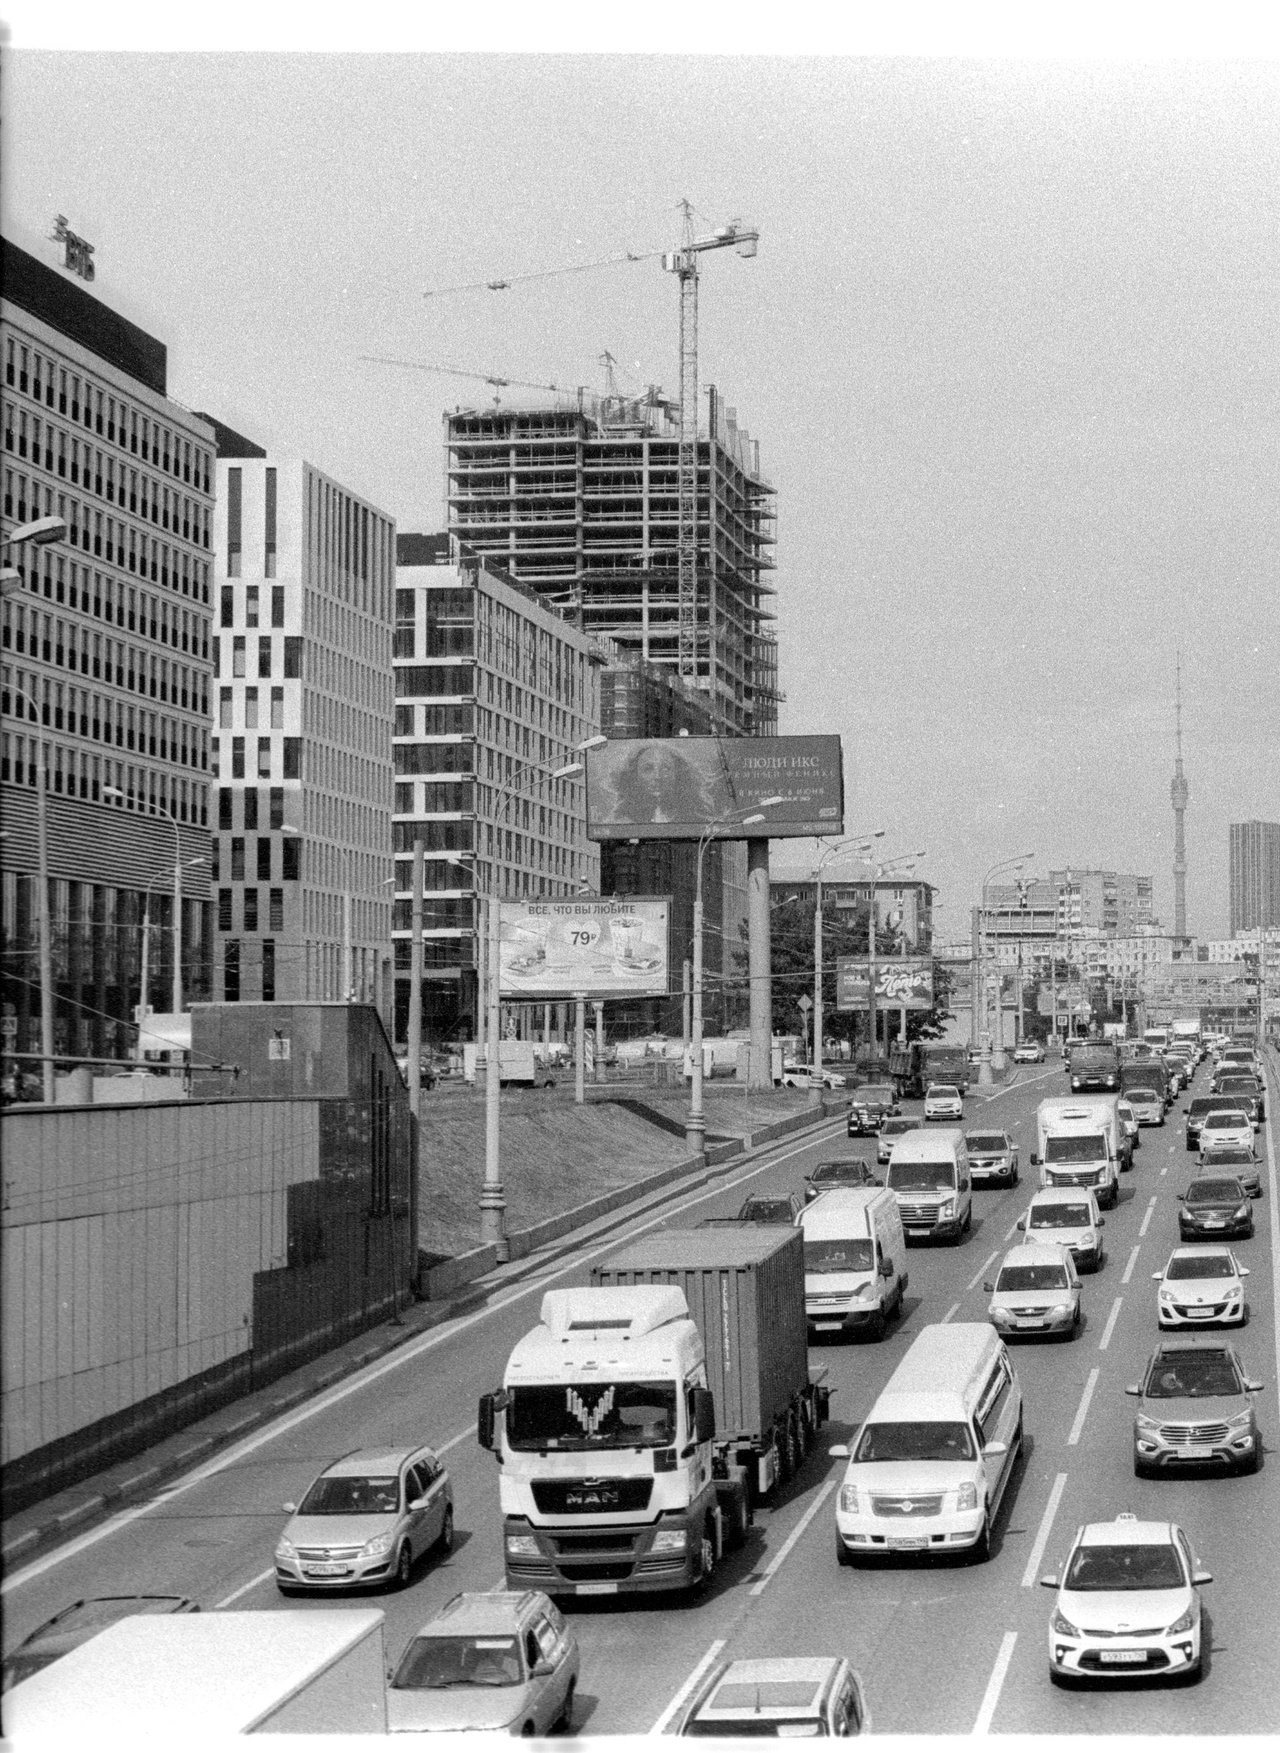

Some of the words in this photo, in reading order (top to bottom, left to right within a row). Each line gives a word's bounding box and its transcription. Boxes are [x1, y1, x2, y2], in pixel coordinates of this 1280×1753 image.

[792, 756, 819, 767] ИКС
[554, 906, 572, 914] ЧТО
[575, 906, 591, 914] ВЫ
[593, 905, 635, 914] ЛЮБИТЕ
[567, 1491, 618, 1504] MAN
